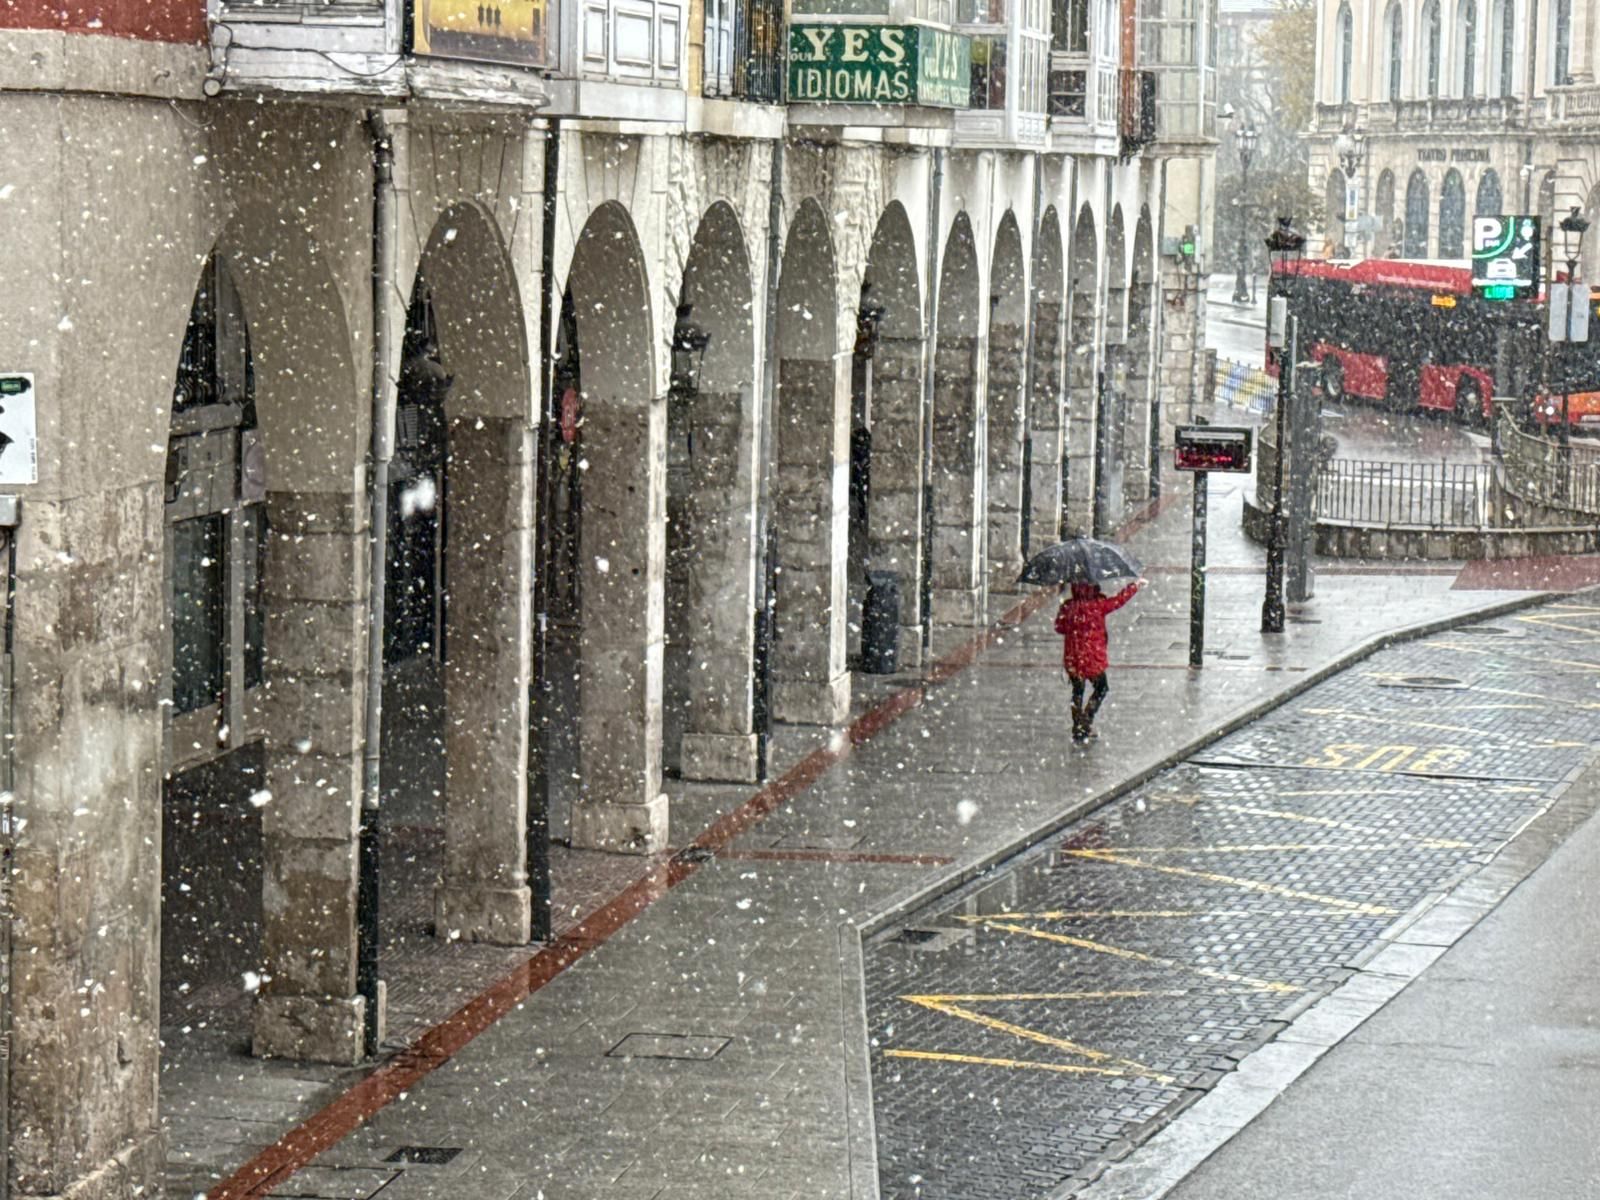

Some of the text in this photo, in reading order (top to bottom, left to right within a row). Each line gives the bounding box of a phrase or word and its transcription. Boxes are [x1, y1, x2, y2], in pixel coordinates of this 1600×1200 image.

[802, 27, 906, 64] YES
[797, 68, 910, 100] IDIOMAS
[1474, 217, 1502, 251] P
